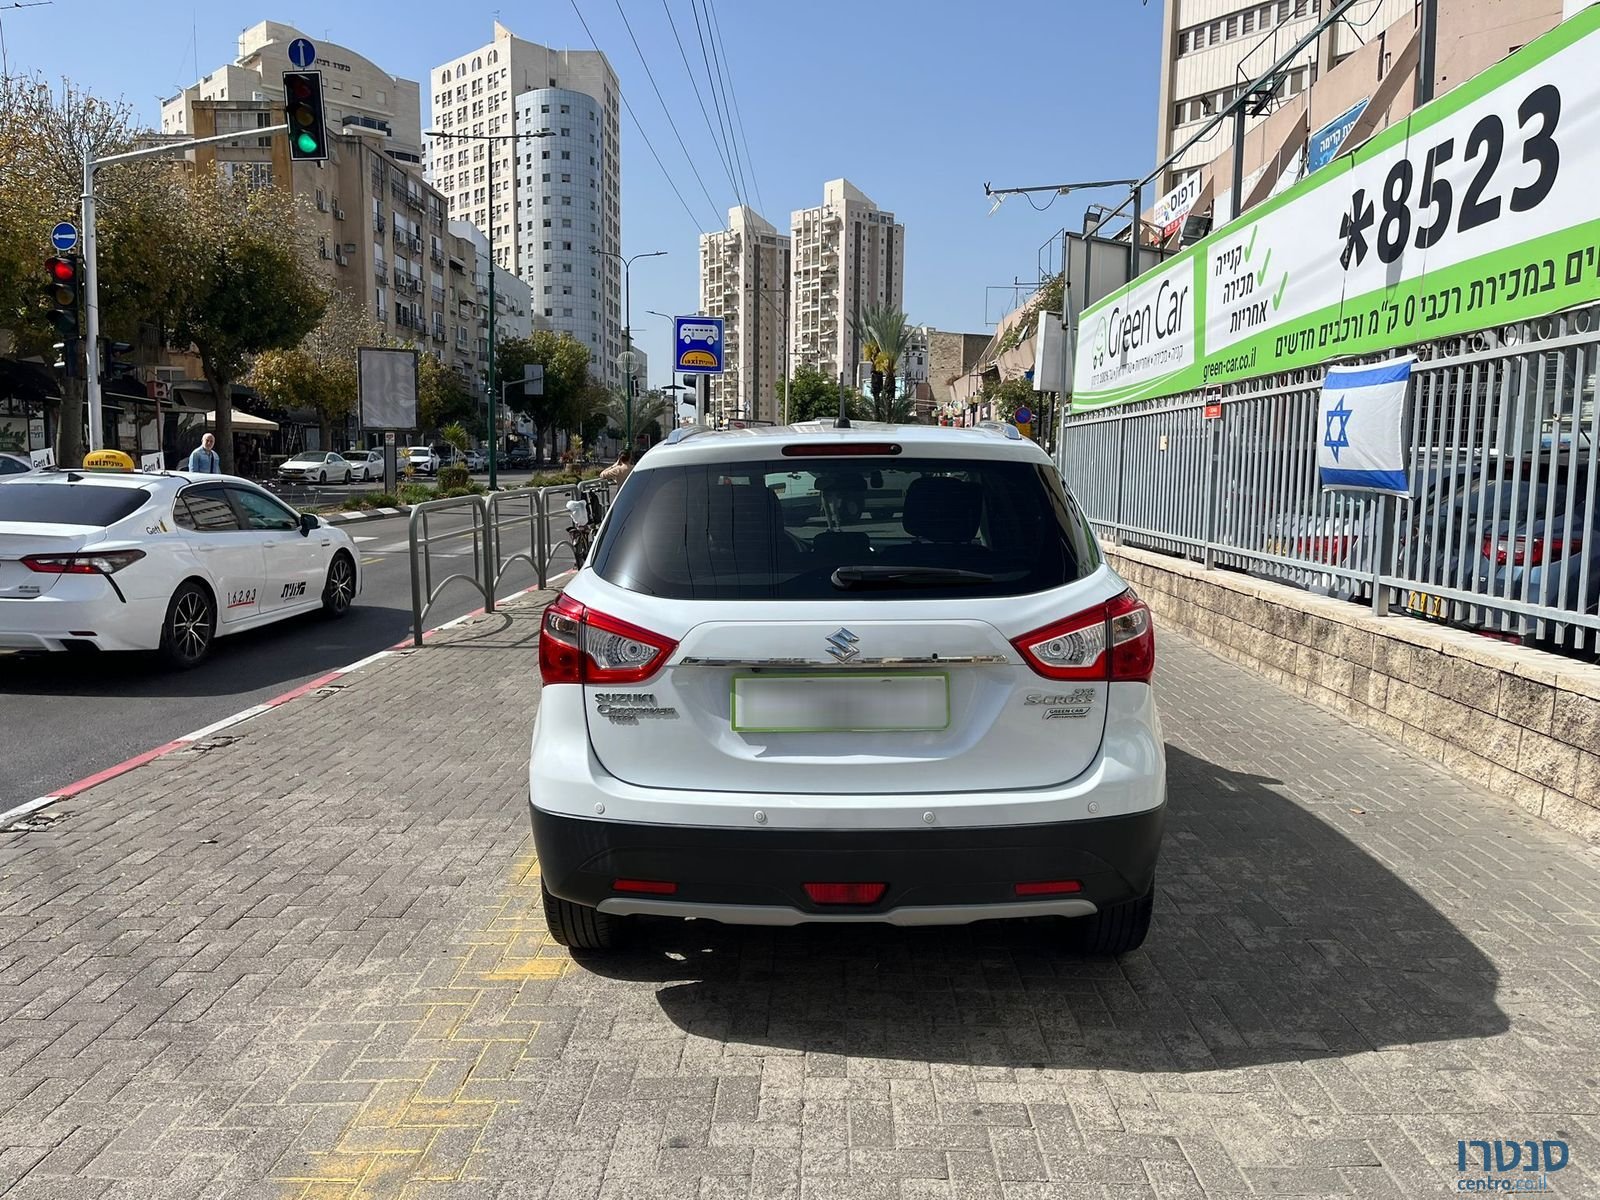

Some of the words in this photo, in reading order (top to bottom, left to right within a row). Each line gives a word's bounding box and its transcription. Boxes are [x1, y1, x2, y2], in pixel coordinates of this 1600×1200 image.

[1320, 129, 1341, 152] קדימה
[1170, 180, 1194, 212] דפוס
[1215, 245, 1243, 276] קנייה
[1223, 272, 1254, 304] מכירה
[1467, 259, 1555, 311] במכירת
[1108, 304, 1151, 358] Green
[1155, 279, 1188, 339] Car
[1229, 299, 1268, 333] אחריות
[1404, 294, 1416, 327] 0
[1421, 286, 1461, 322] רכבי
[1275, 327, 1315, 358] חדשים
[1318, 314, 1364, 347] ורכבים
[685, 356, 698, 365] taxi
[1203, 347, 1256, 382] green-car.co.il
[87, 457, 101, 467] taxi
[594, 693, 656, 704] SUZUKI
